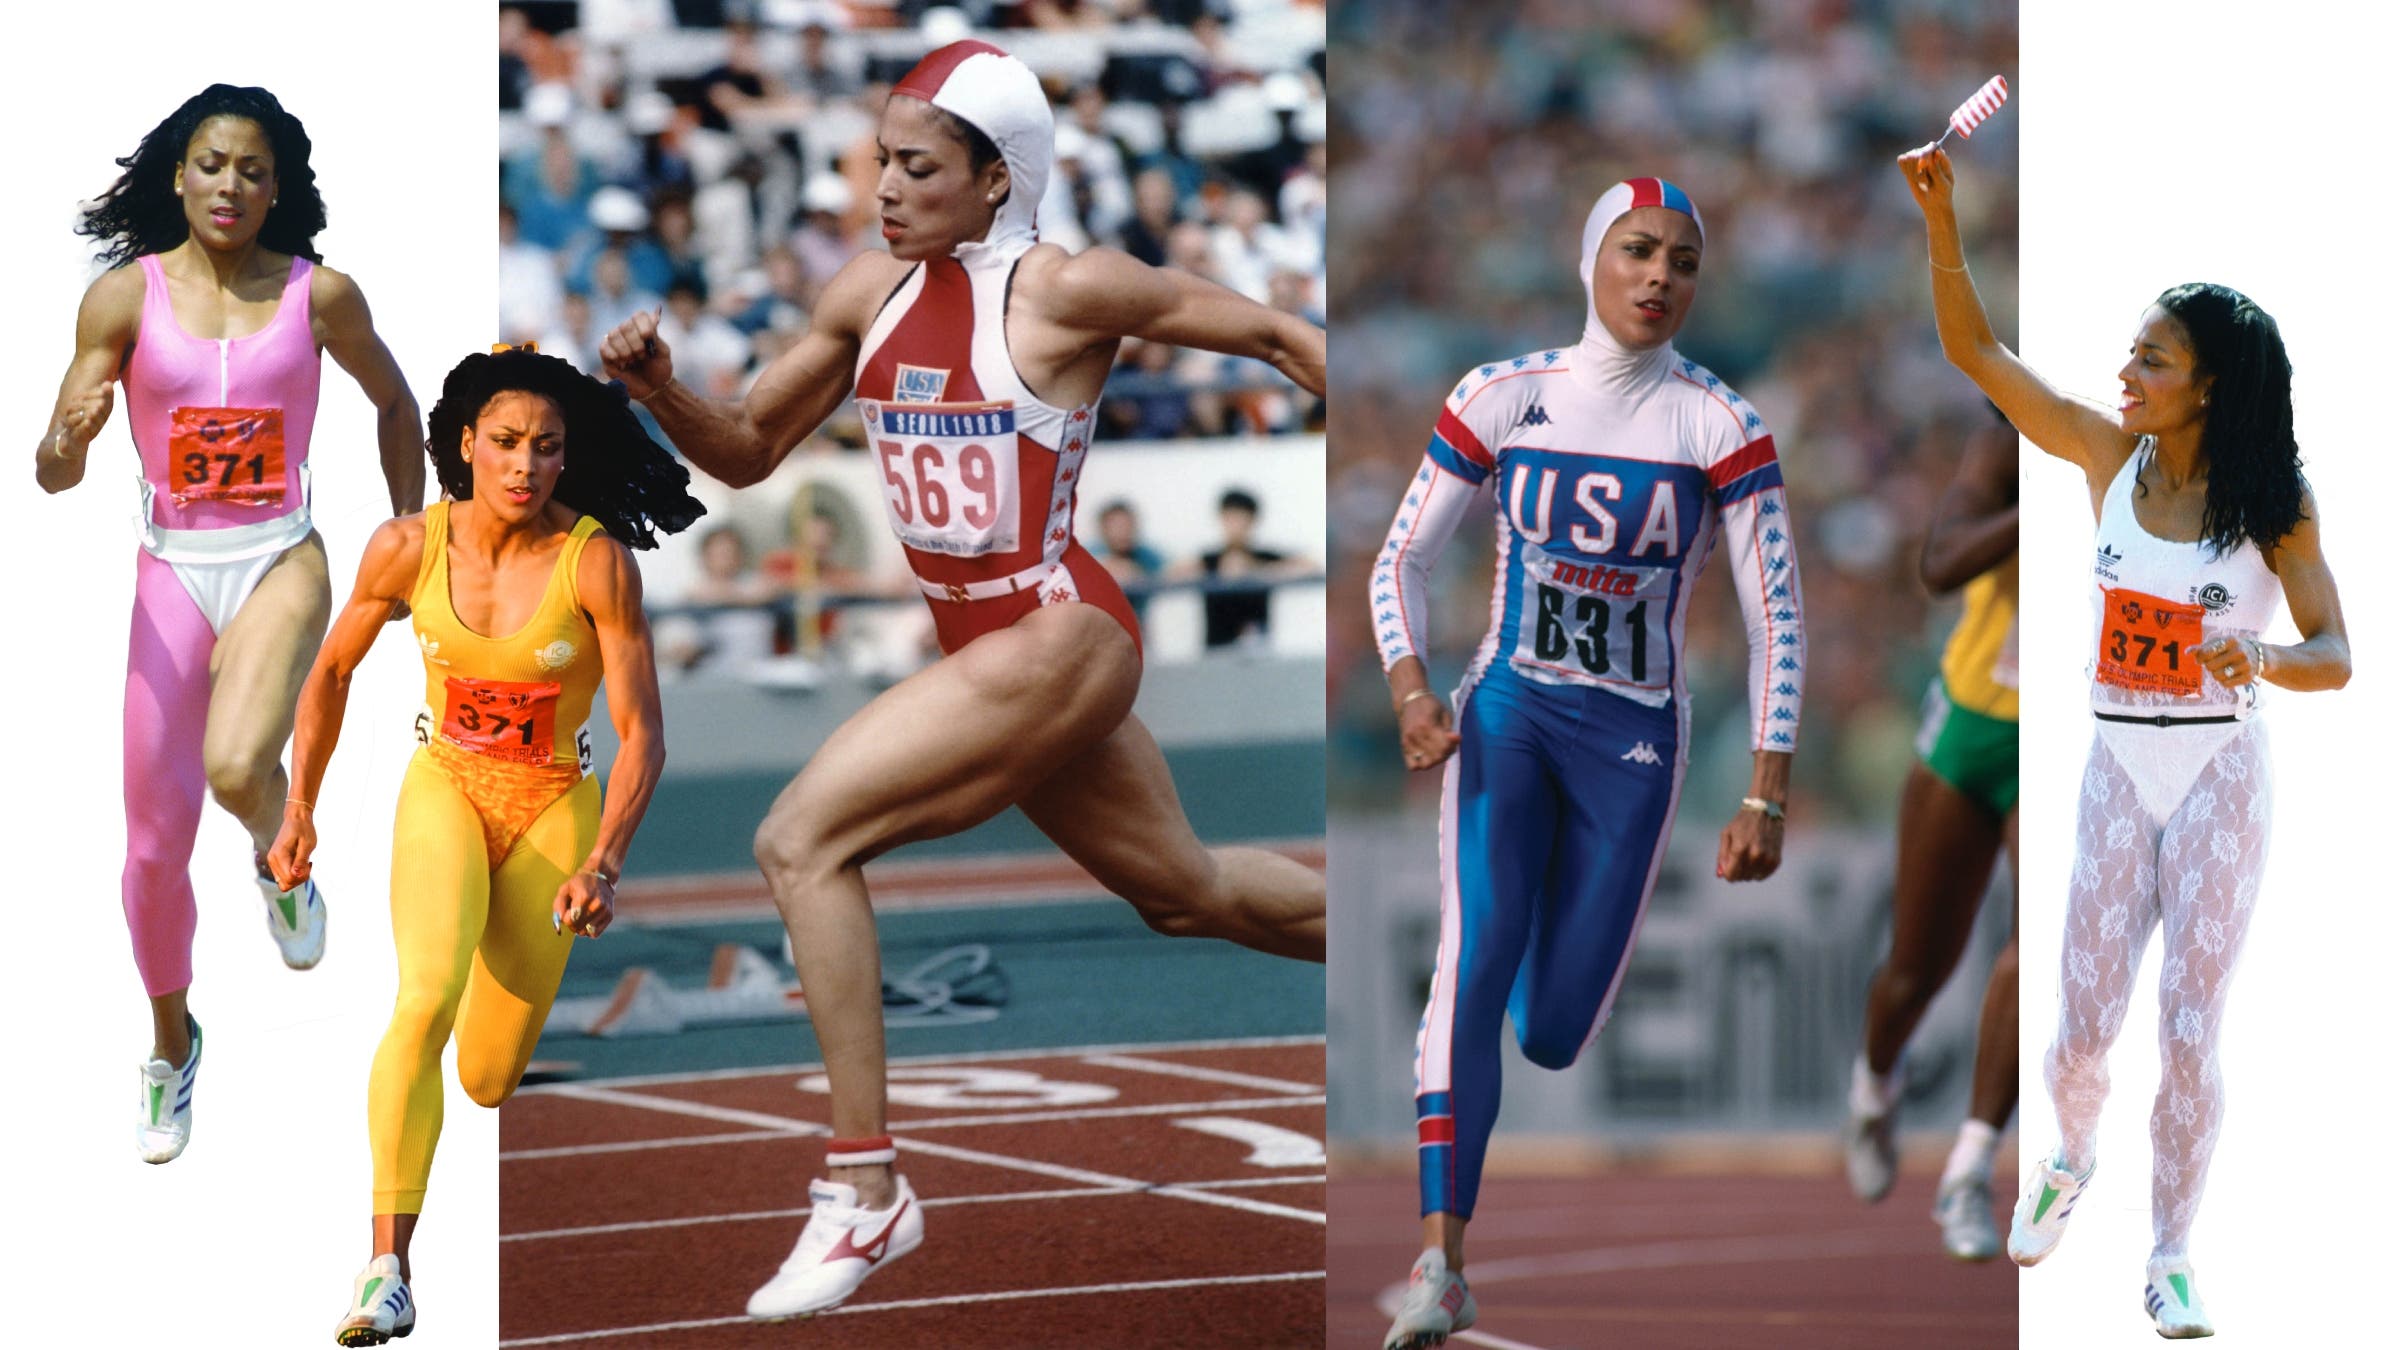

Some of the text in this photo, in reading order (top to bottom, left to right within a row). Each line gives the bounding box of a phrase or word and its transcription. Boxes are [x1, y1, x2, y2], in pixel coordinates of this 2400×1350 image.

[901, 370, 941, 394] USA
[896, 413, 1002, 435] SEOUL 1988
[183, 452, 264, 487] 371
[877, 439, 998, 530] 569
[1509, 463, 1679, 557] USA
[1552, 560, 1638, 595] mita
[2206, 588, 2224, 602] ICI
[1535, 582, 1647, 682] 631
[2110, 629, 2179, 671] 371
[2161, 673, 2198, 688] TRIALS
[457, 702, 534, 746] 371
